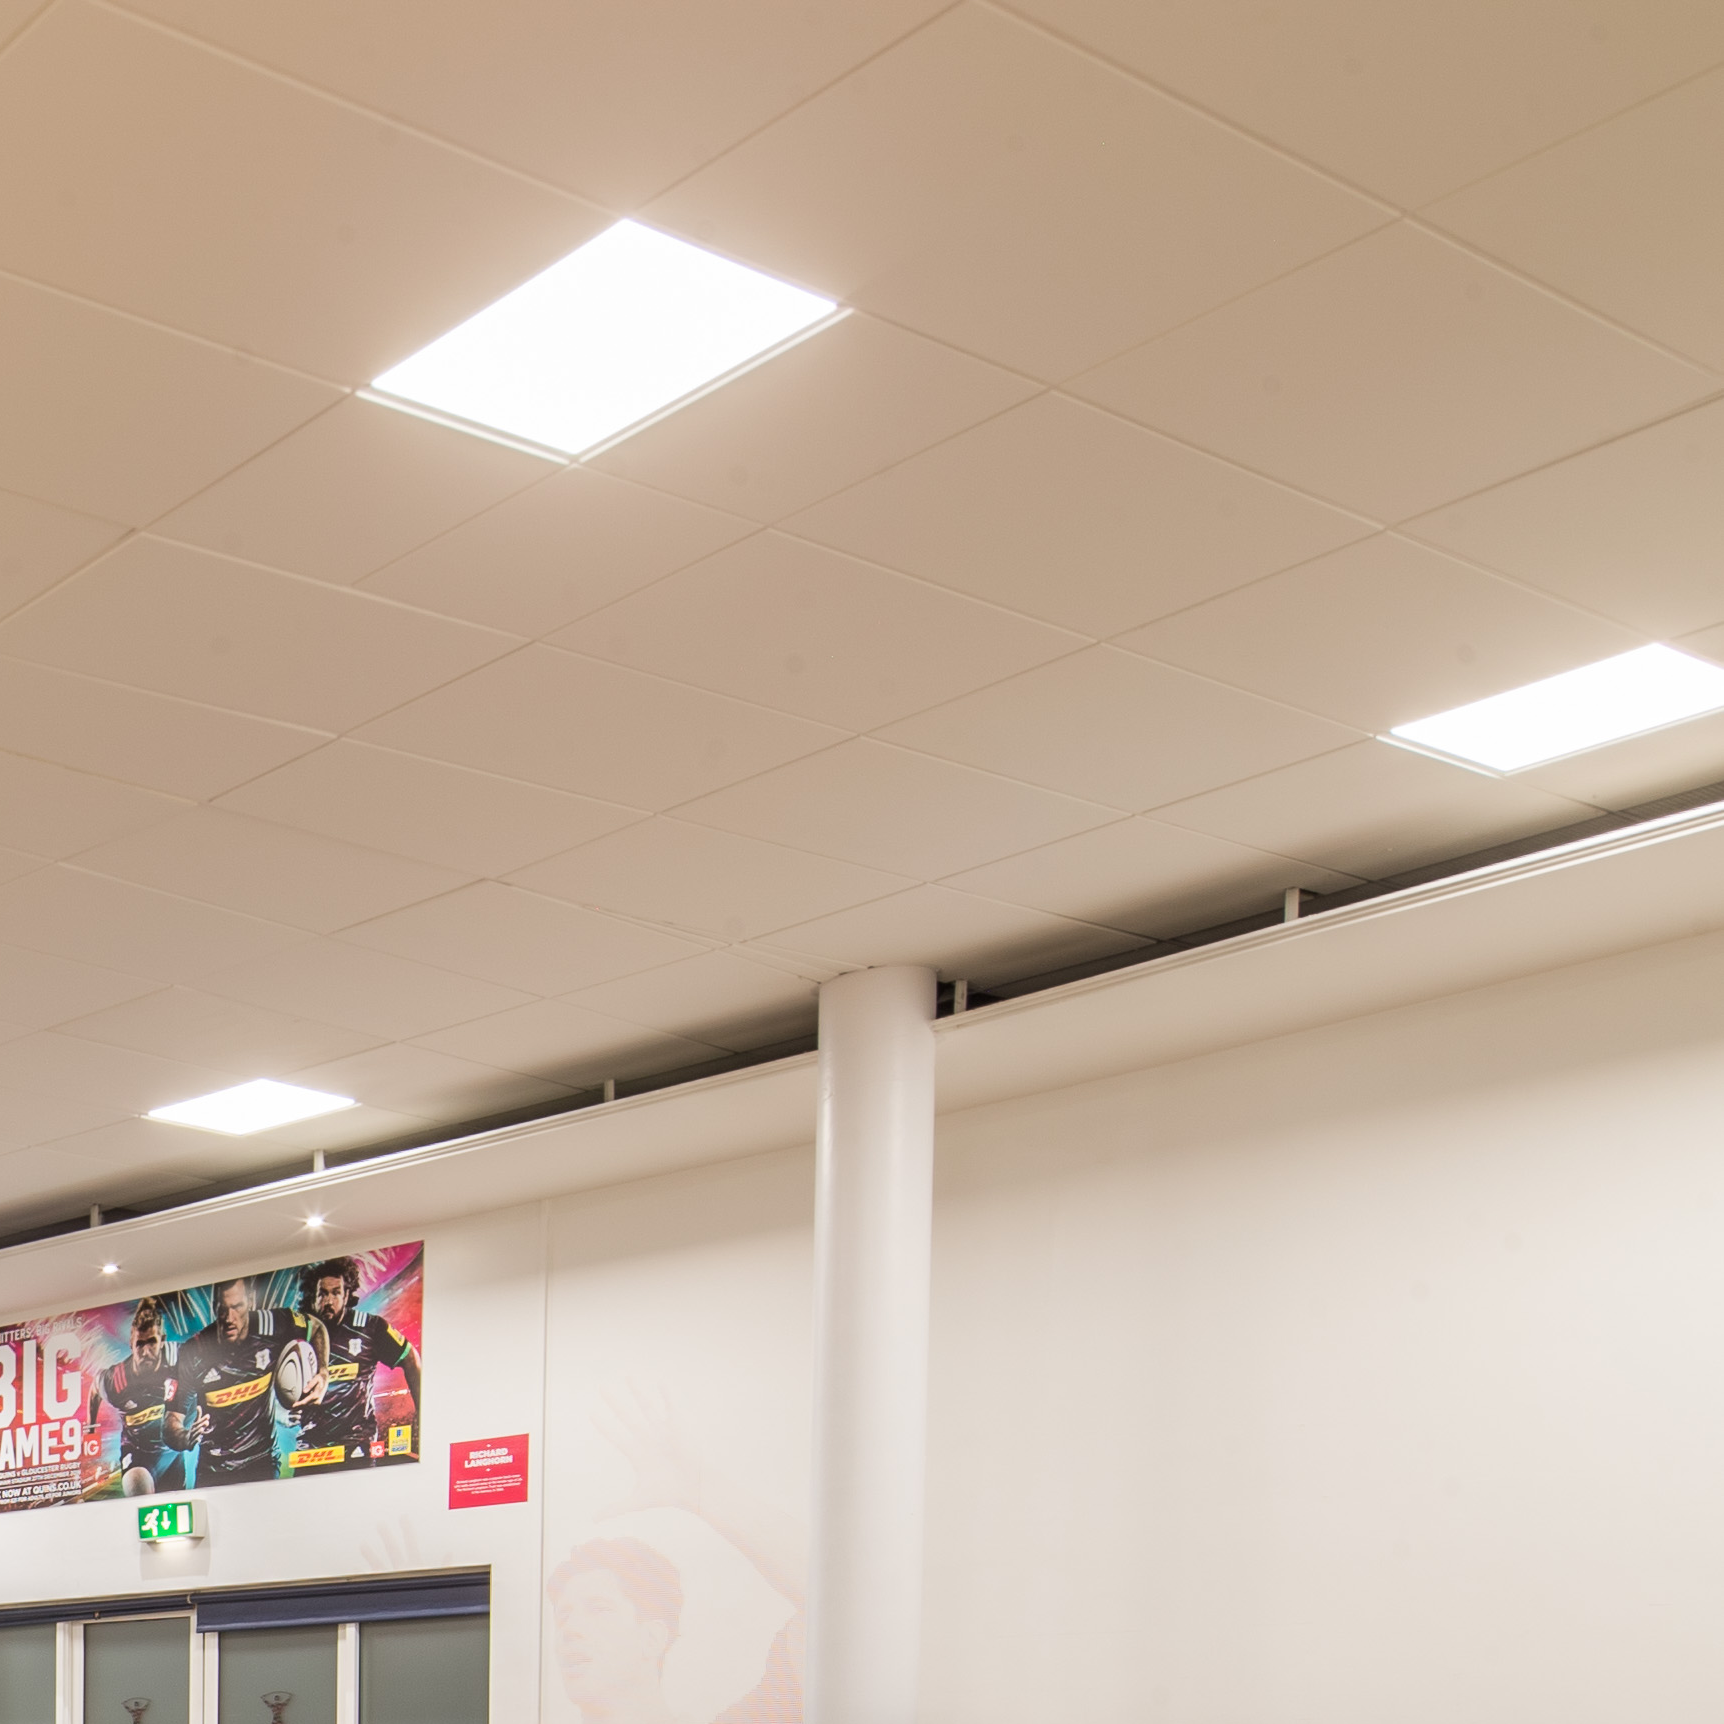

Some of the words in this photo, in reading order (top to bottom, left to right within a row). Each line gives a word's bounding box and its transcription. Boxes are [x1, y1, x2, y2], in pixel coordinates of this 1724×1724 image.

[215, 1383, 259, 1404] DHL
[84, 1440, 99, 1456] IG
[469, 1447, 509, 1459] RICHARD
[297, 1450, 335, 1464] DHL
[464, 1455, 513, 1468] LANGHORN
[2, 1488, 21, 1498] NOW
[22, 1487, 31, 1495] AT
